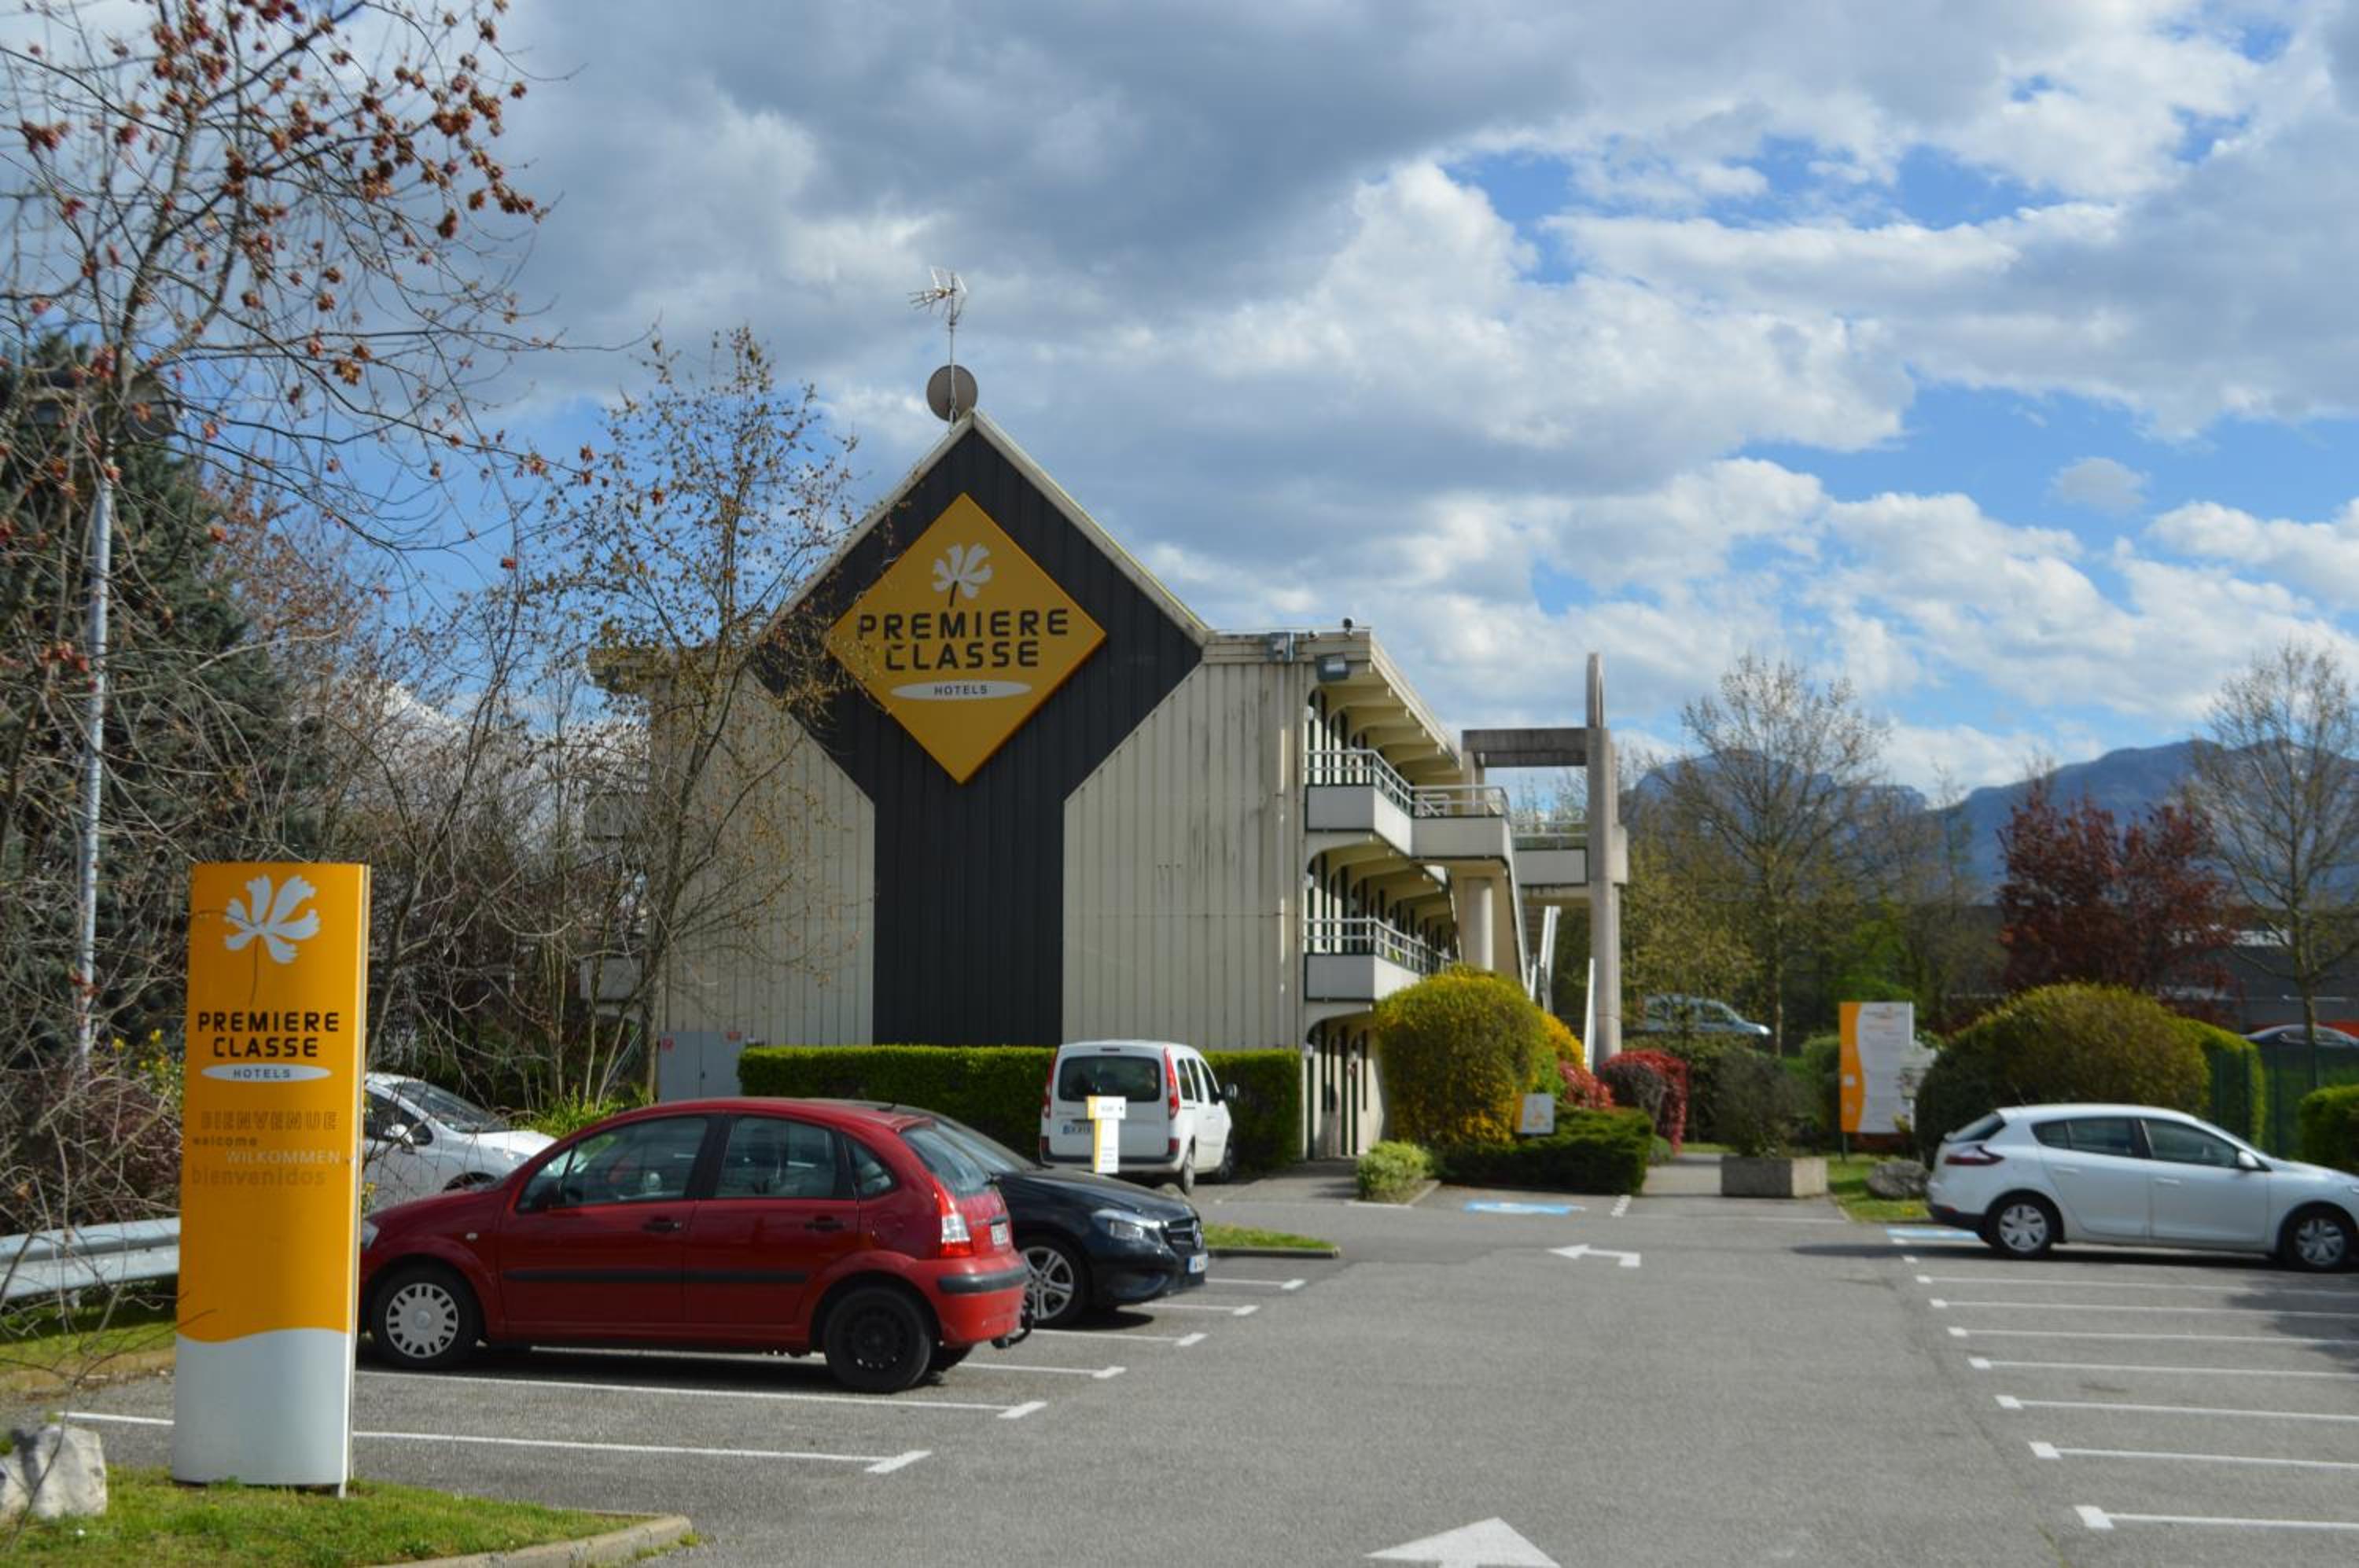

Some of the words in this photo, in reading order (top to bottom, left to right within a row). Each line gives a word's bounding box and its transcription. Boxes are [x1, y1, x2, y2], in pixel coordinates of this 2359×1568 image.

[858, 609, 1069, 640] PREMIERE
[886, 642, 1039, 670] CLASSE
[934, 685, 988, 696] HOTELS
[198, 1012, 339, 1032] PREMIERE
[213, 1037, 318, 1058] CLASSE
[234, 1069, 291, 1078] HOTELS
[201, 1110, 340, 1130] BIENVENUE
[192, 1136, 258, 1146] welcome
[191, 1165, 327, 1185] bienvenidos
